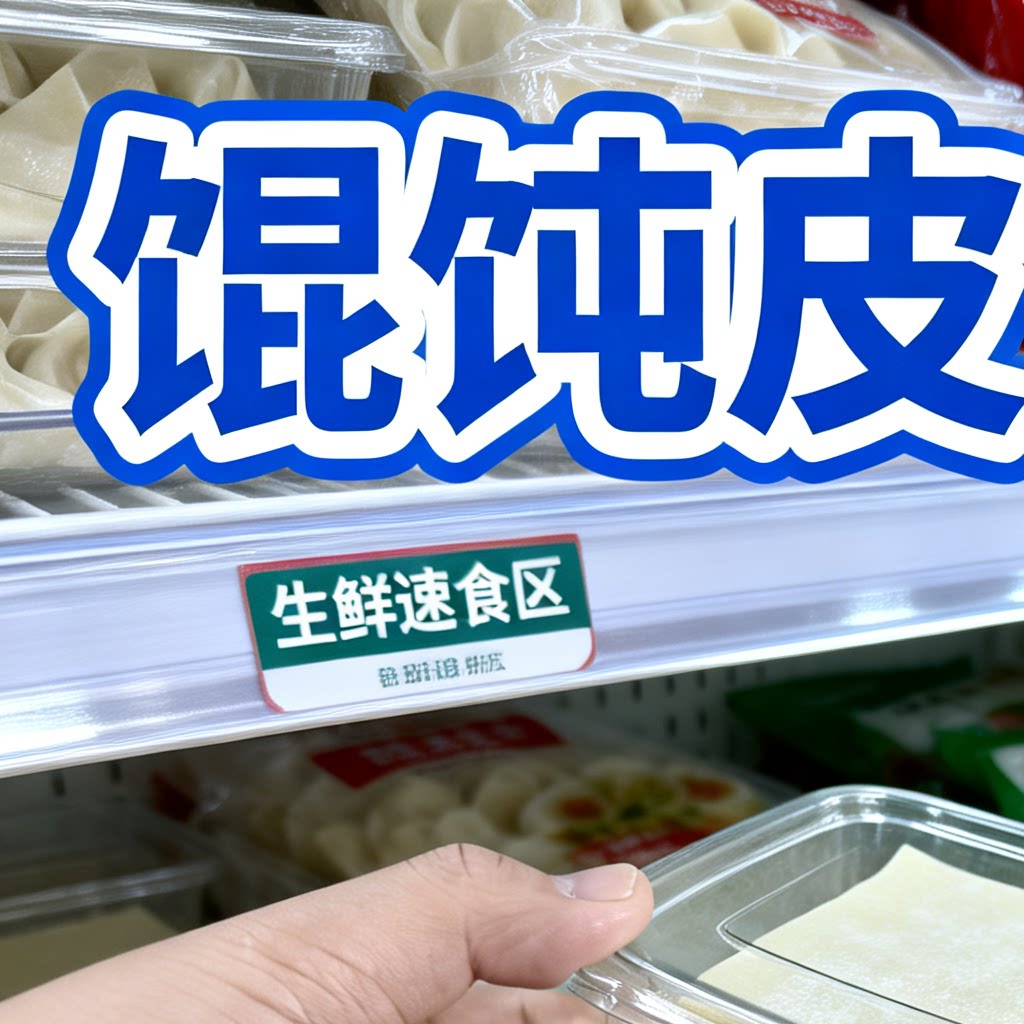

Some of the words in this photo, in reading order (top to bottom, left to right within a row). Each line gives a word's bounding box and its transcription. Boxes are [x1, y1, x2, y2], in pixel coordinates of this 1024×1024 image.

[271, 555, 571, 649] 生鲜速食区
